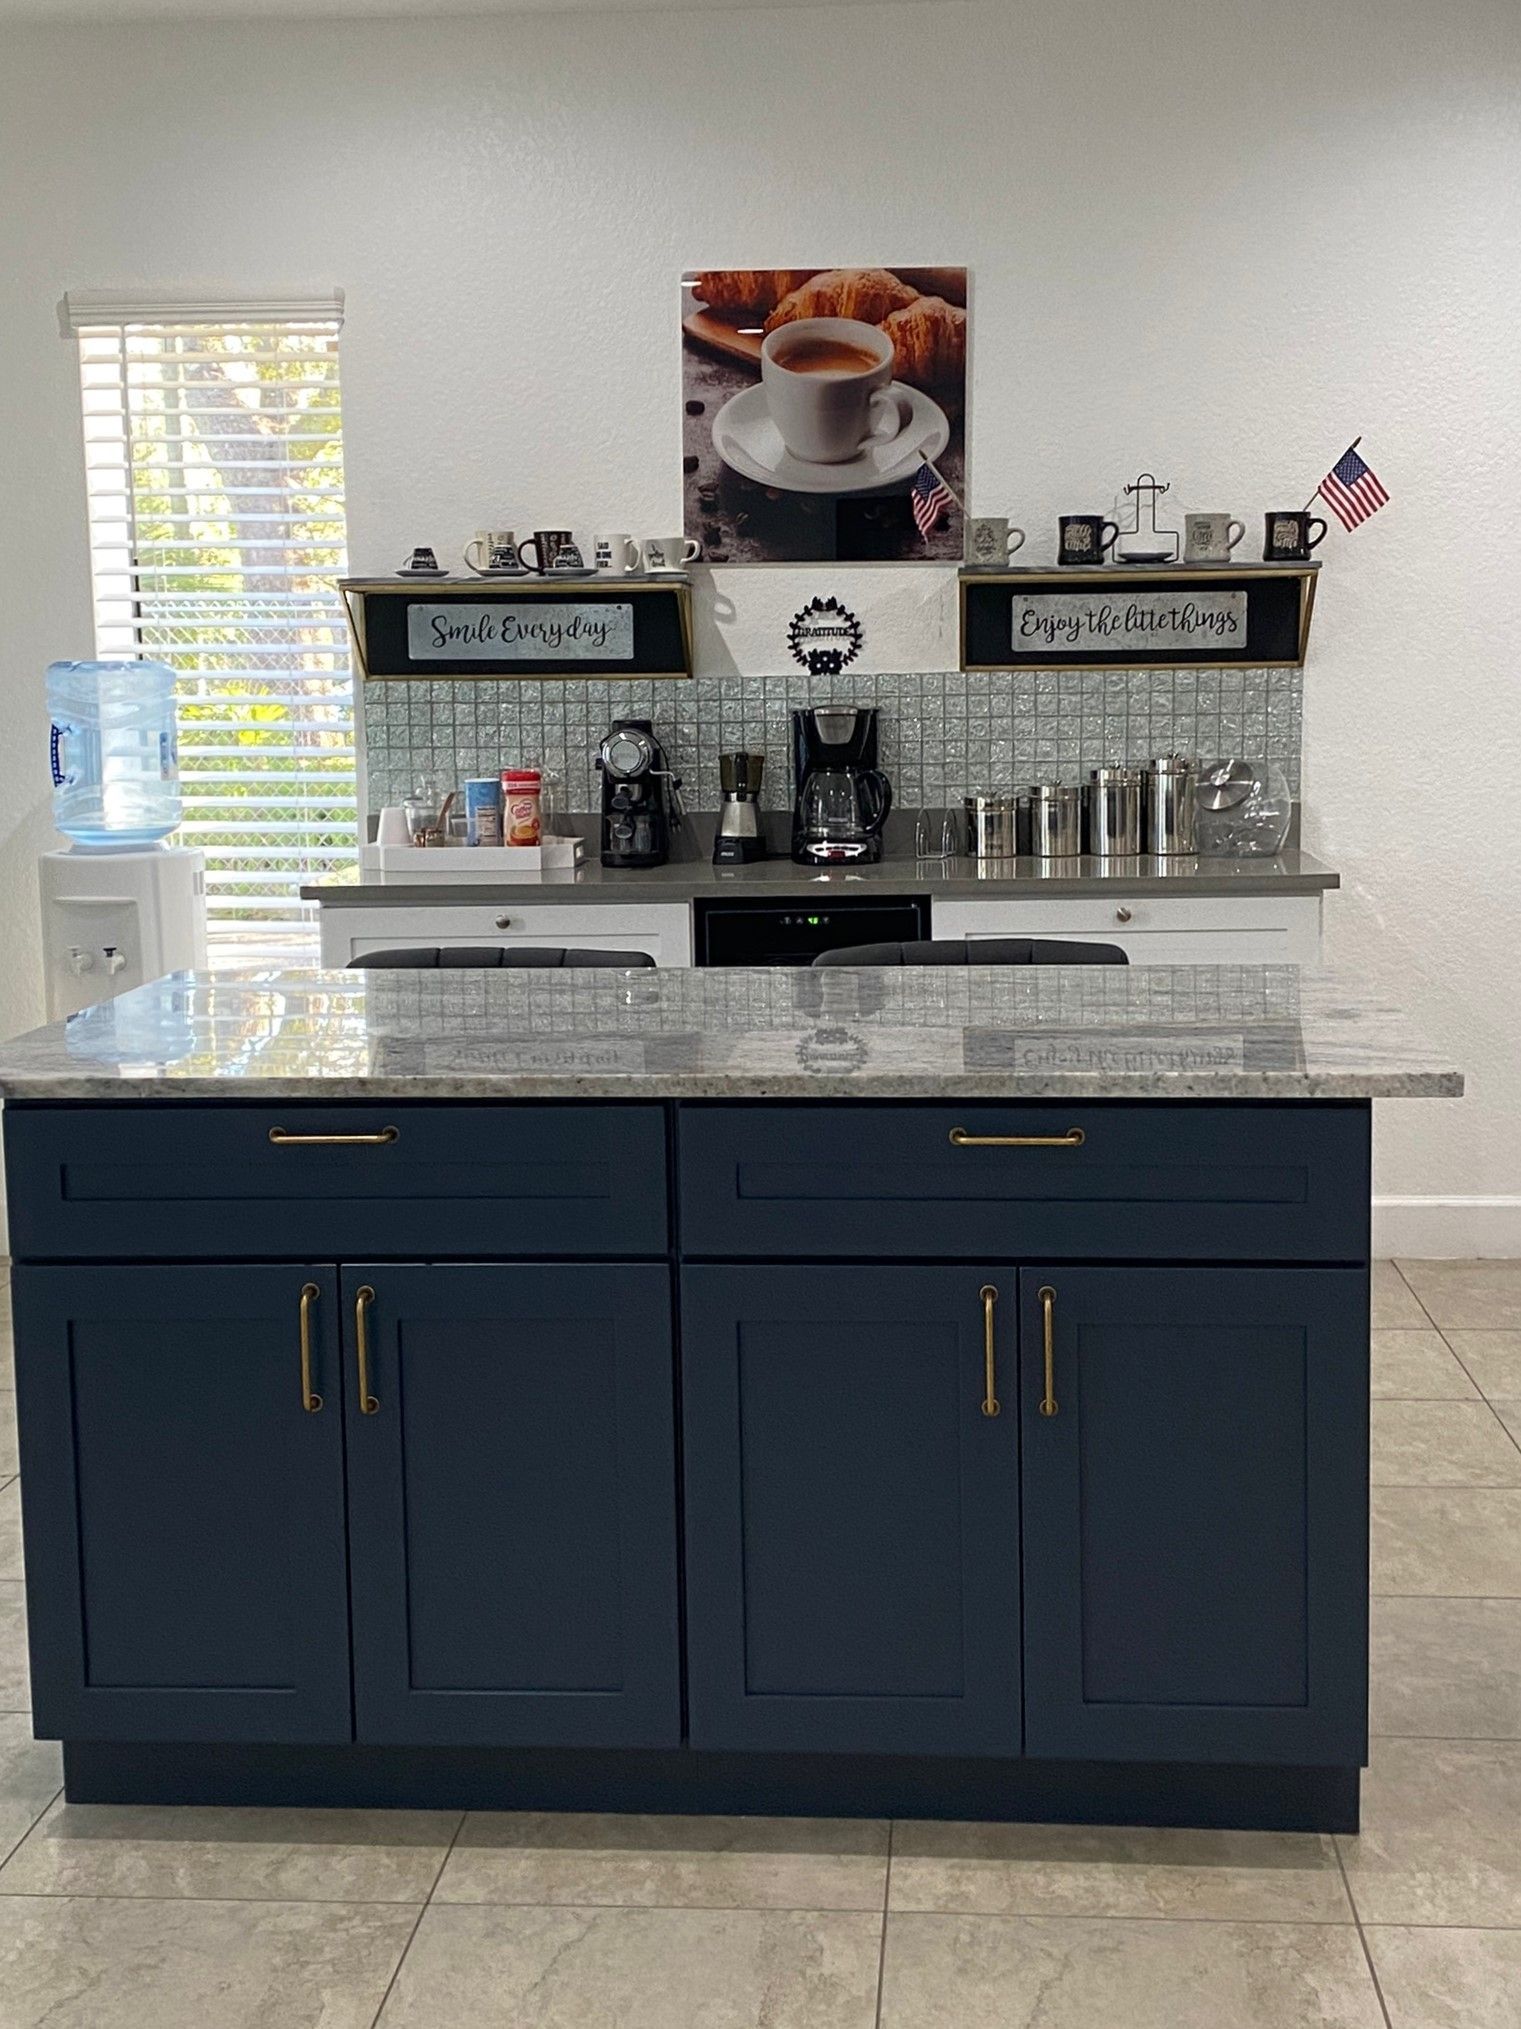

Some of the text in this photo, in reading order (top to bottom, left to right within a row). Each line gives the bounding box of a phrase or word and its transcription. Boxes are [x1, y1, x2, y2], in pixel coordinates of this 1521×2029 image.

[431, 614, 498, 648] Smile
[797, 627, 850, 637] GRATITUDE
[1020, 609, 1085, 643] Enjoy
[1084, 605, 1122, 636] the
[1167, 602, 1239, 635] things
